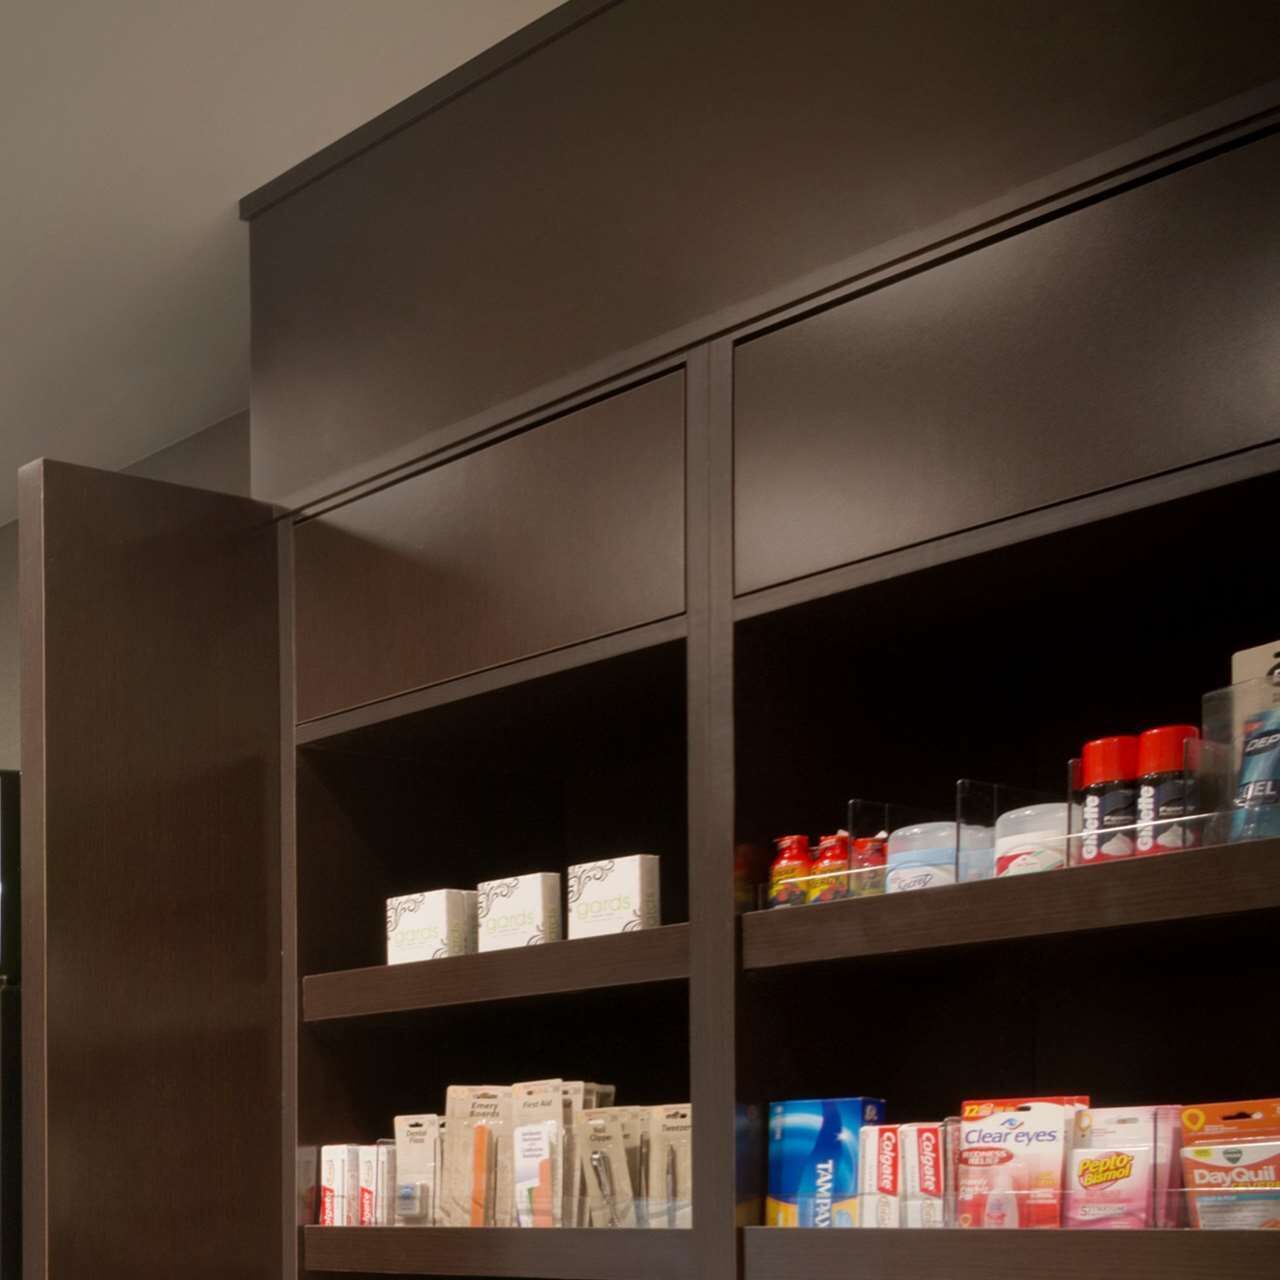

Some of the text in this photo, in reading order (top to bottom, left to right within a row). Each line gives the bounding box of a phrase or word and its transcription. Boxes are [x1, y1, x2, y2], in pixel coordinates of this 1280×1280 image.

[965, 1128, 1057, 1147] Clear eyes
[878, 1131, 897, 1192] Colgate
[920, 1131, 938, 1192] Colgate
[1079, 1154, 1135, 1173] Pepto-
[1084, 1167, 1132, 1186] Bismol
[1193, 1165, 1276, 1188] DayQuil
